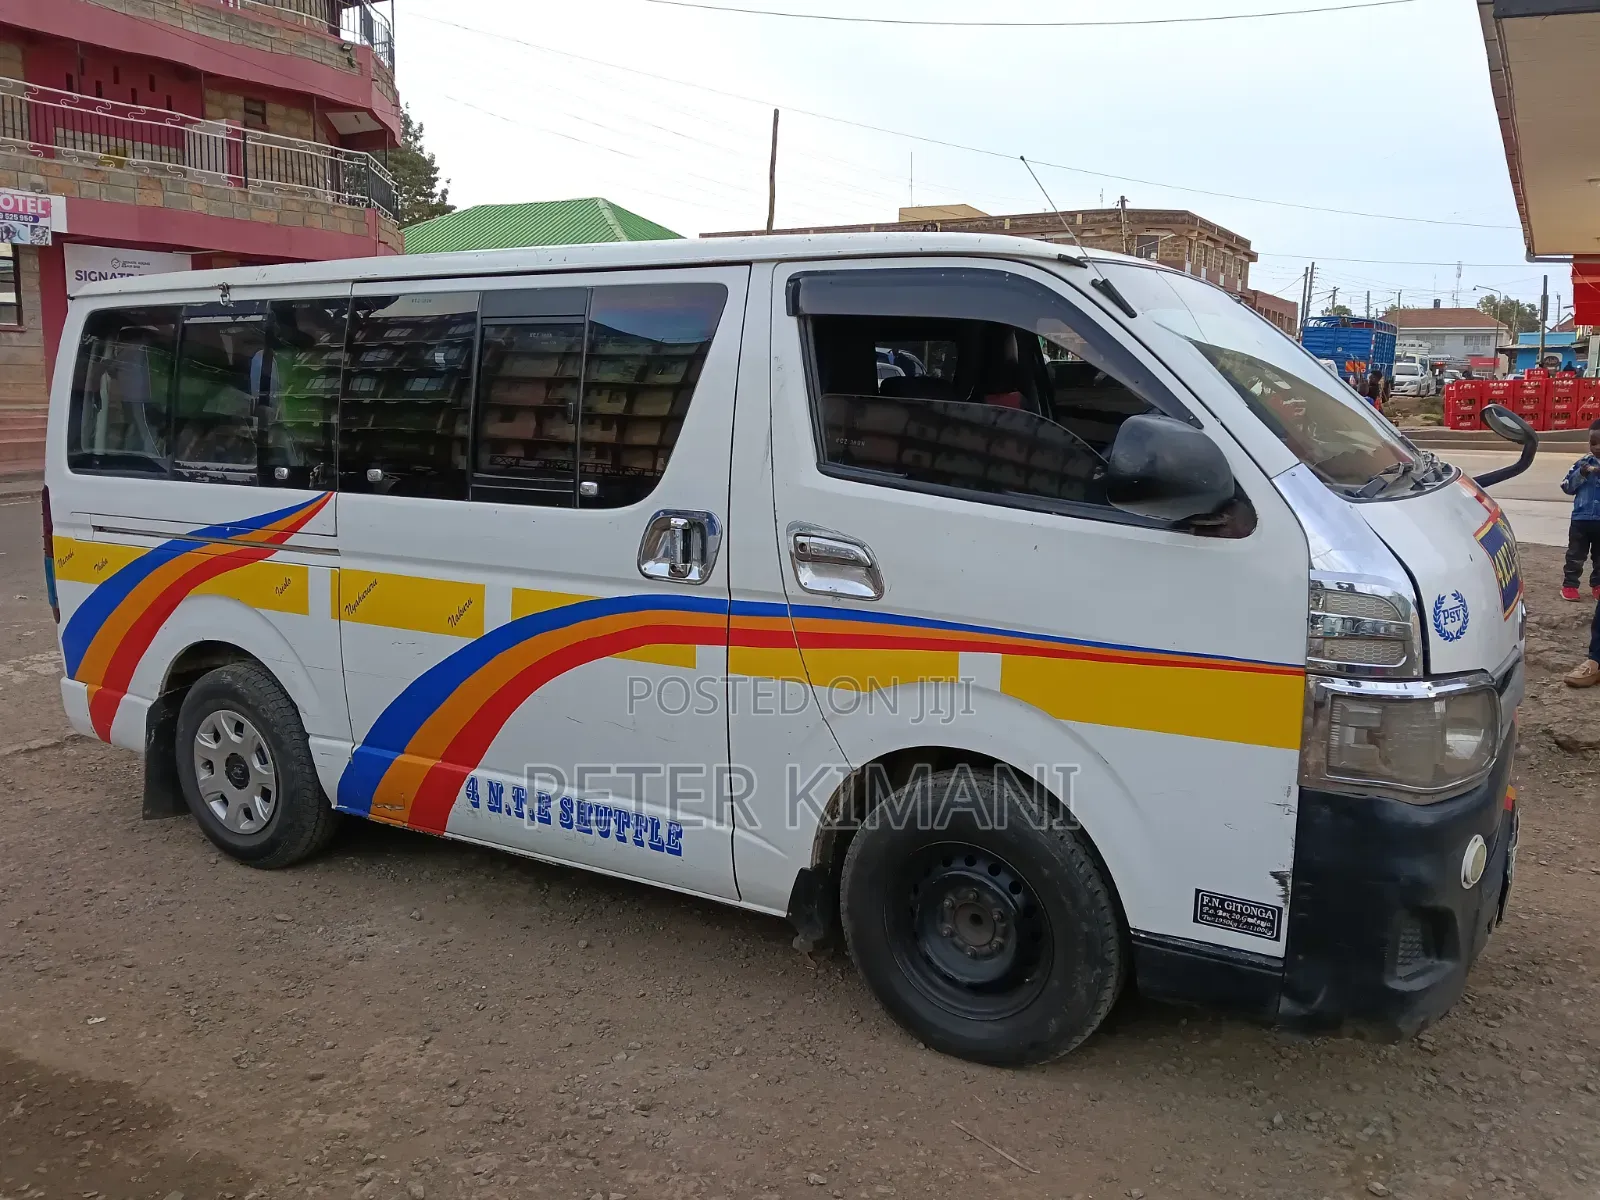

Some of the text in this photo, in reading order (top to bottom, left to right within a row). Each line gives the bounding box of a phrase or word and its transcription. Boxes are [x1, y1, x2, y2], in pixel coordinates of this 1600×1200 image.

[344, 578, 378, 616] Nyahururu
[447, 597, 474, 628] Nakuru
[465, 775, 480, 809] 4
[559, 796, 683, 857] SHUTTLE
[1203, 896, 1274, 920] F.N. GITONGA
